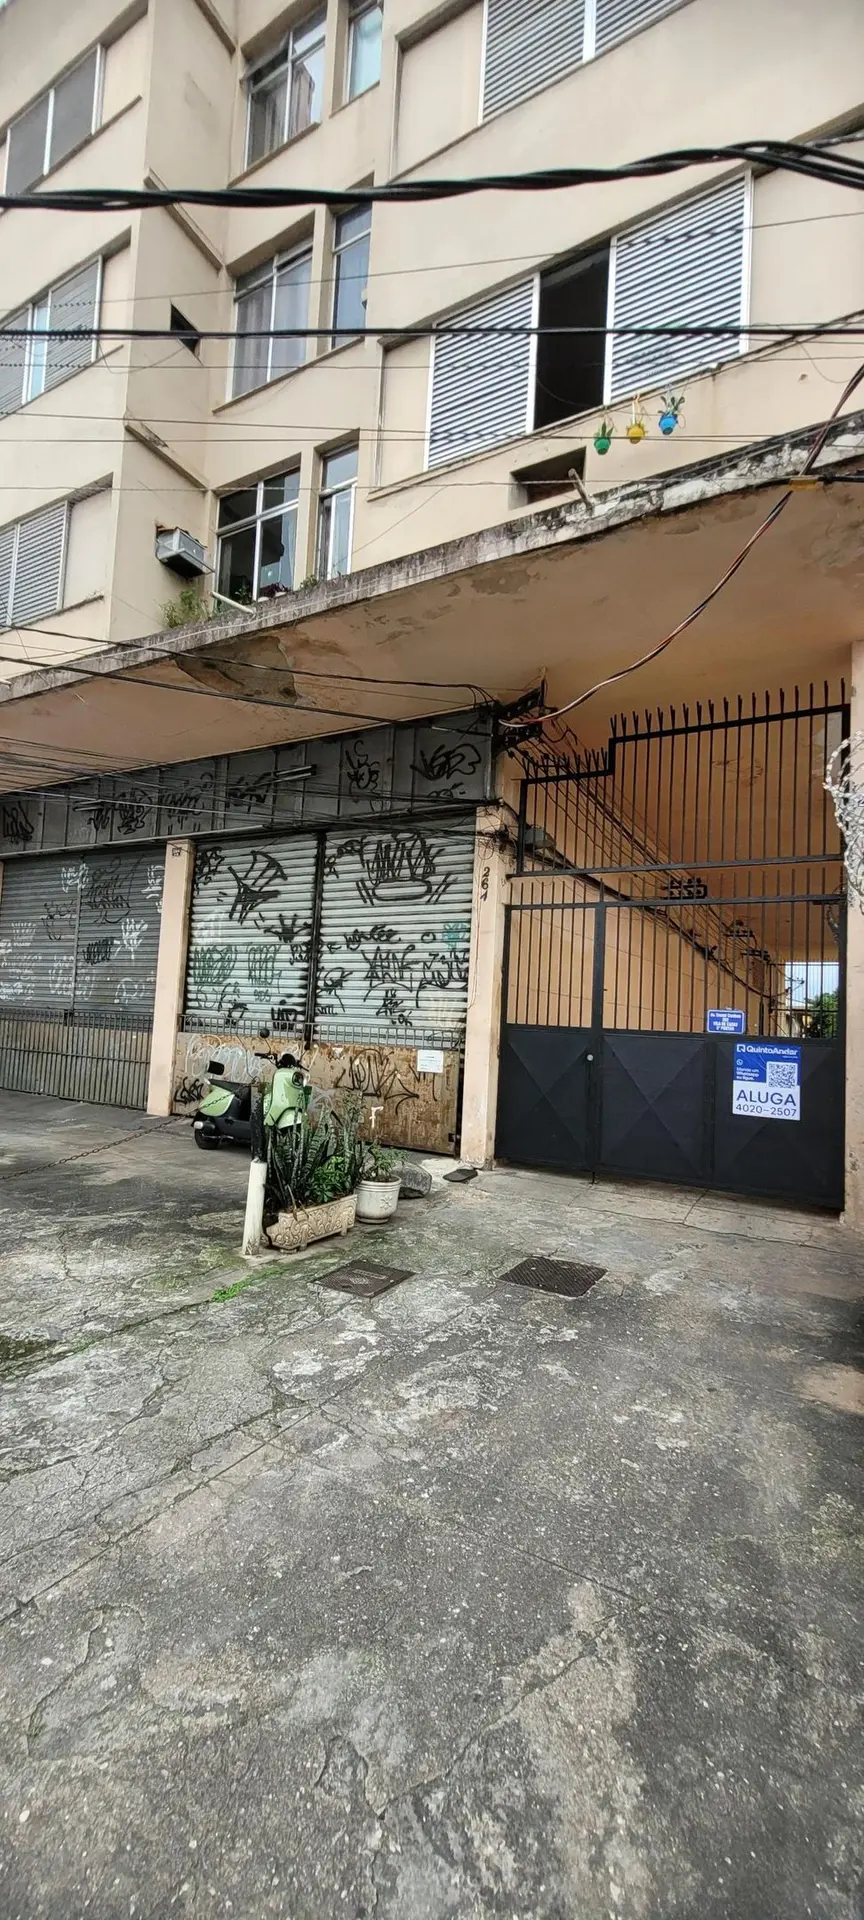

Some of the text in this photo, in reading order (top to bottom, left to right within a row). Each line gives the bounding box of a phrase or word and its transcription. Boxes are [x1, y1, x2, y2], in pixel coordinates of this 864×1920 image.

[480, 866, 490, 902] 261
[746, 1045, 798, 1055] QuintoAndar
[736, 1089, 796, 1106] ALUGA
[735, 1103, 797, 1117] 4020-2507
